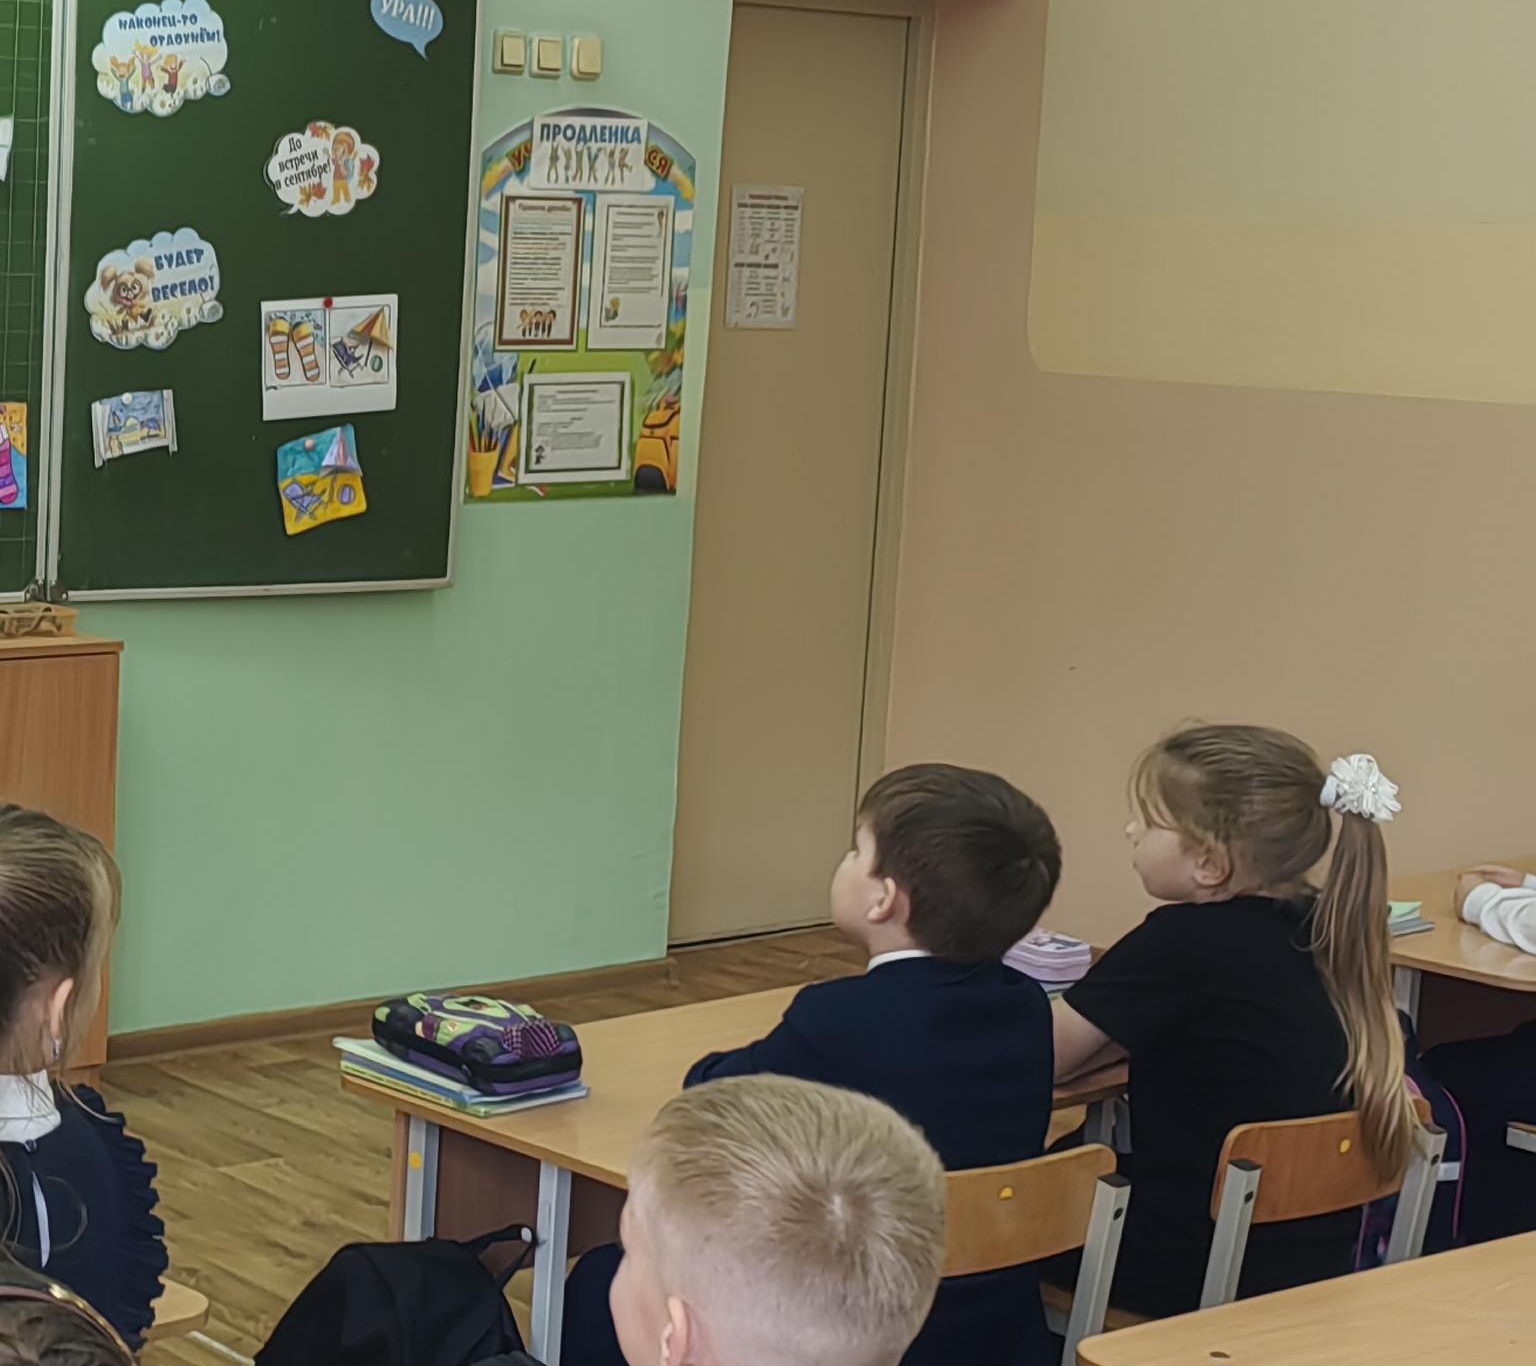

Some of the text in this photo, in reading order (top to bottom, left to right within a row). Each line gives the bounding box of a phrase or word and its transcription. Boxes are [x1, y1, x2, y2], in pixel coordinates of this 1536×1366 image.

[288, 137, 302, 153] До
[540, 123, 641, 145] ПРОДЛЕНКА
[278, 150, 319, 173] встречи
[647, 146, 672, 177] СЯ
